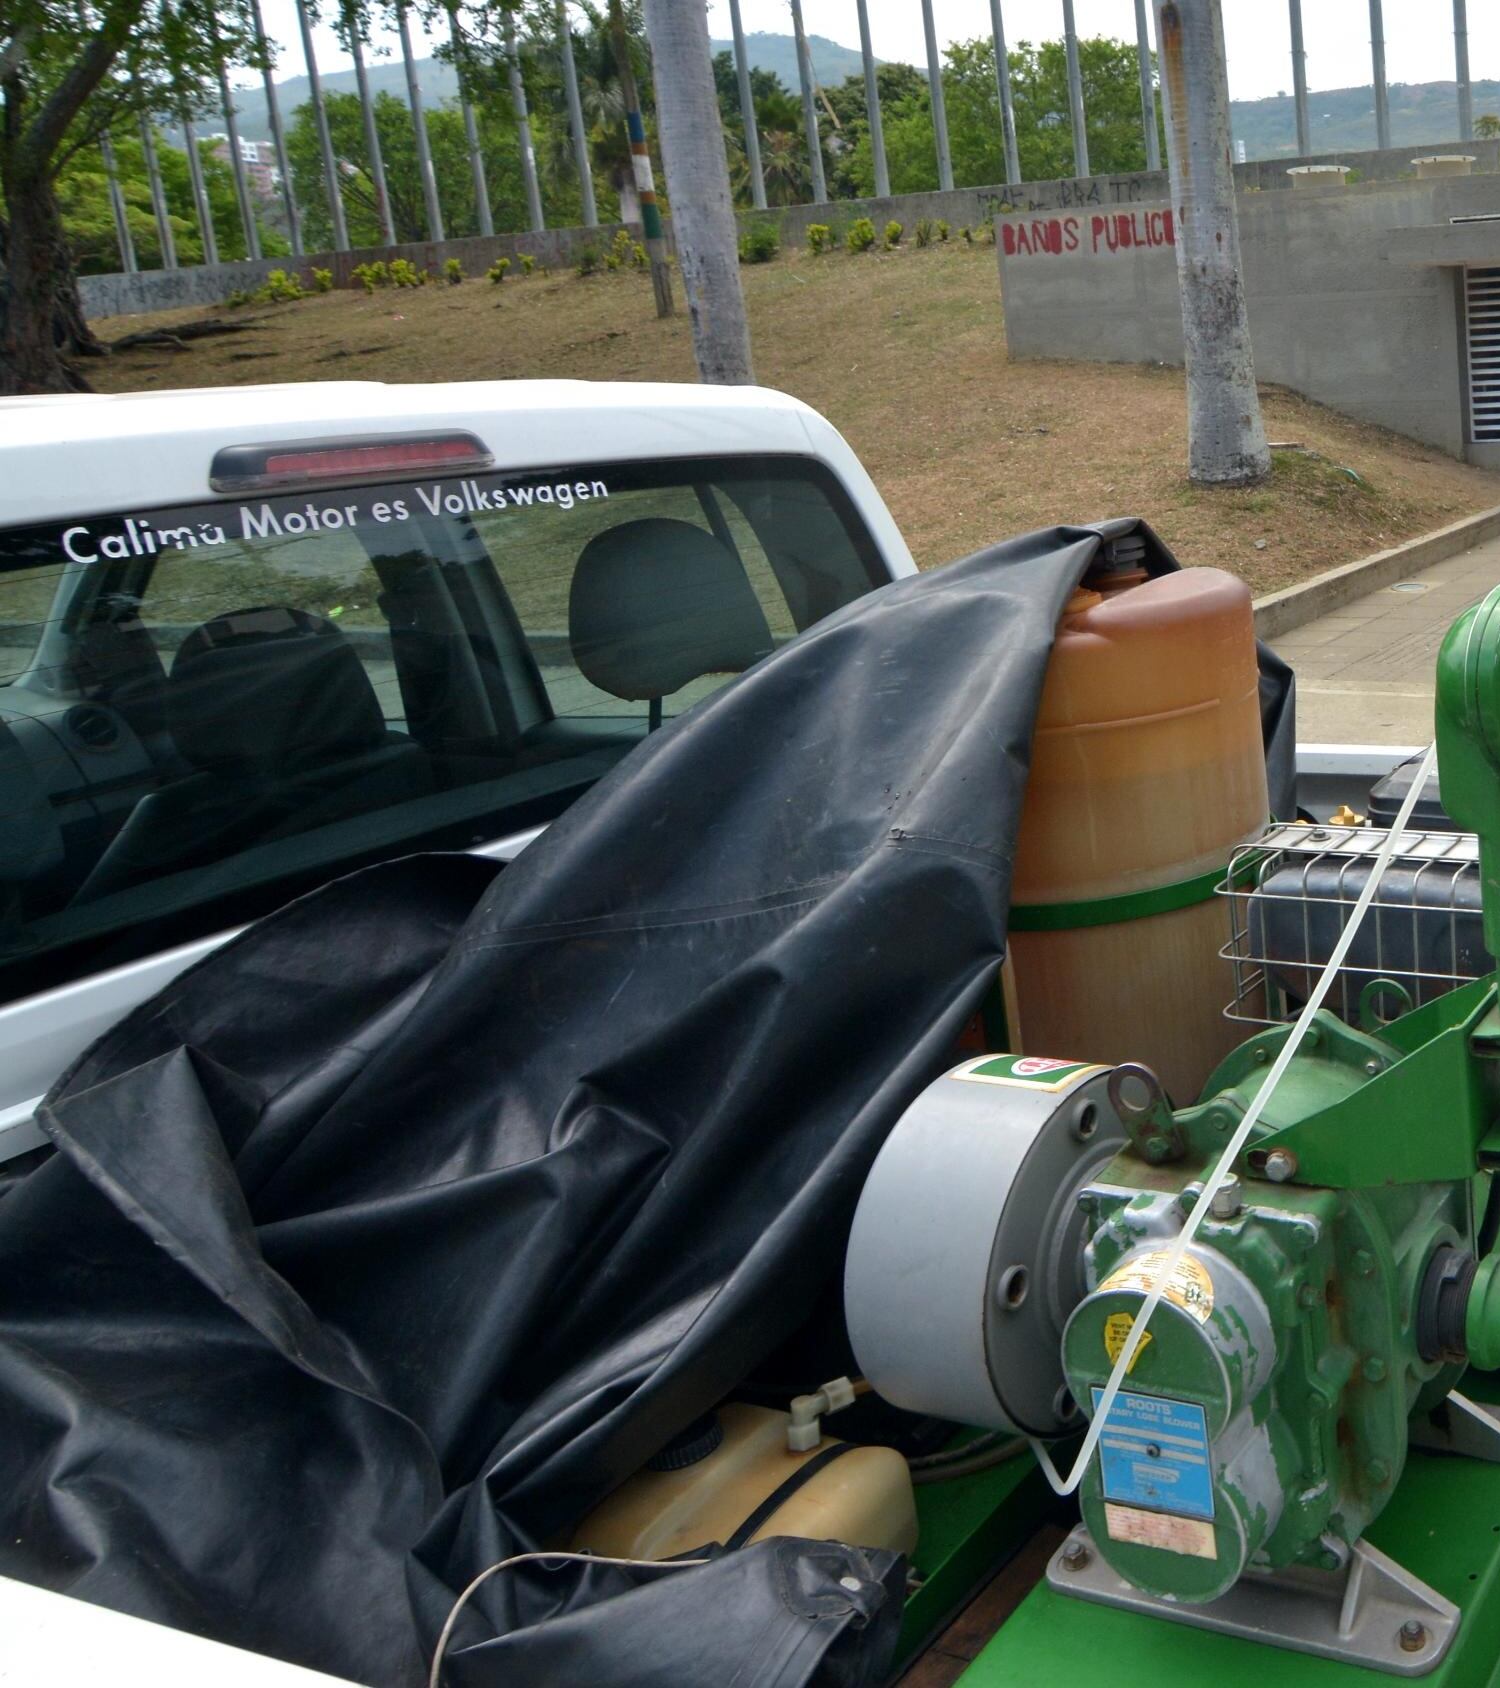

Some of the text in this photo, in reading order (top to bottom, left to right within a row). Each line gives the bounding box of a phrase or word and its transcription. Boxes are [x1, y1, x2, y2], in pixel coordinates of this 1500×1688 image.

[1002, 208, 1185, 256] BAÑOS PUBLICO
[239, 504, 358, 540] Motor
[371, 500, 409, 523] es
[415, 480, 609, 517] Volkswagen
[1126, 1399, 1172, 1415] ROOTS
